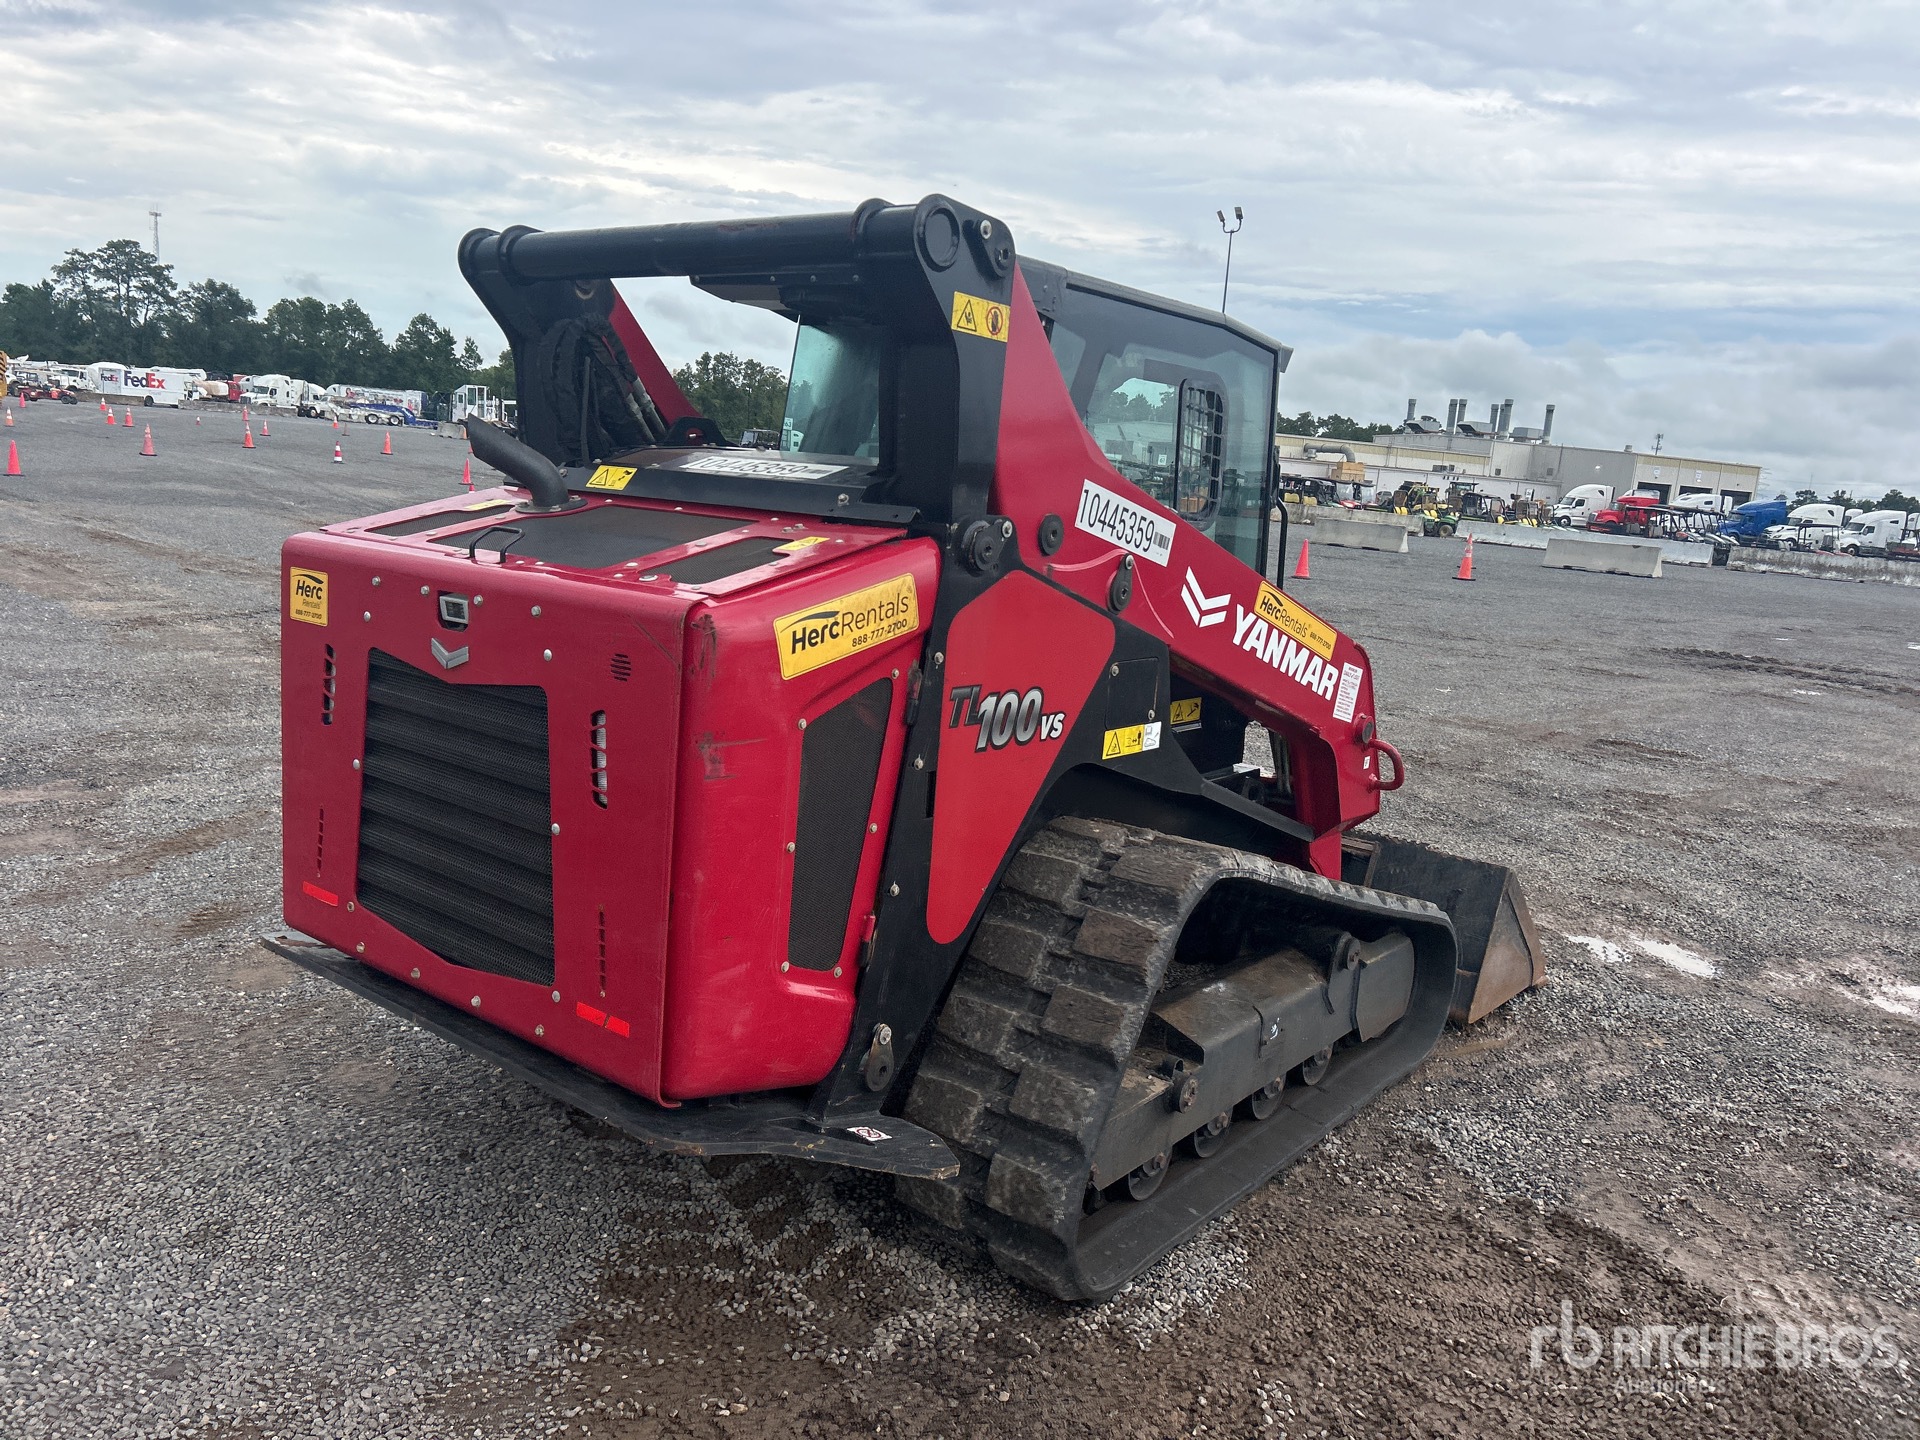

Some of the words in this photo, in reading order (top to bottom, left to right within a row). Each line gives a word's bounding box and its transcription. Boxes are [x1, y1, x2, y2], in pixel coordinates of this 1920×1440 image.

[100, 373, 118, 382] FedEx
[124, 370, 166, 389] FedEx
[691, 458, 808, 475] 10445359
[1080, 489, 1155, 552] 10445359
[295, 579, 323, 600] Herc
[302, 598, 321, 609] Rentals
[852, 618, 908, 647] 888-777-2700
[1232, 603, 1339, 701] YANMAR
